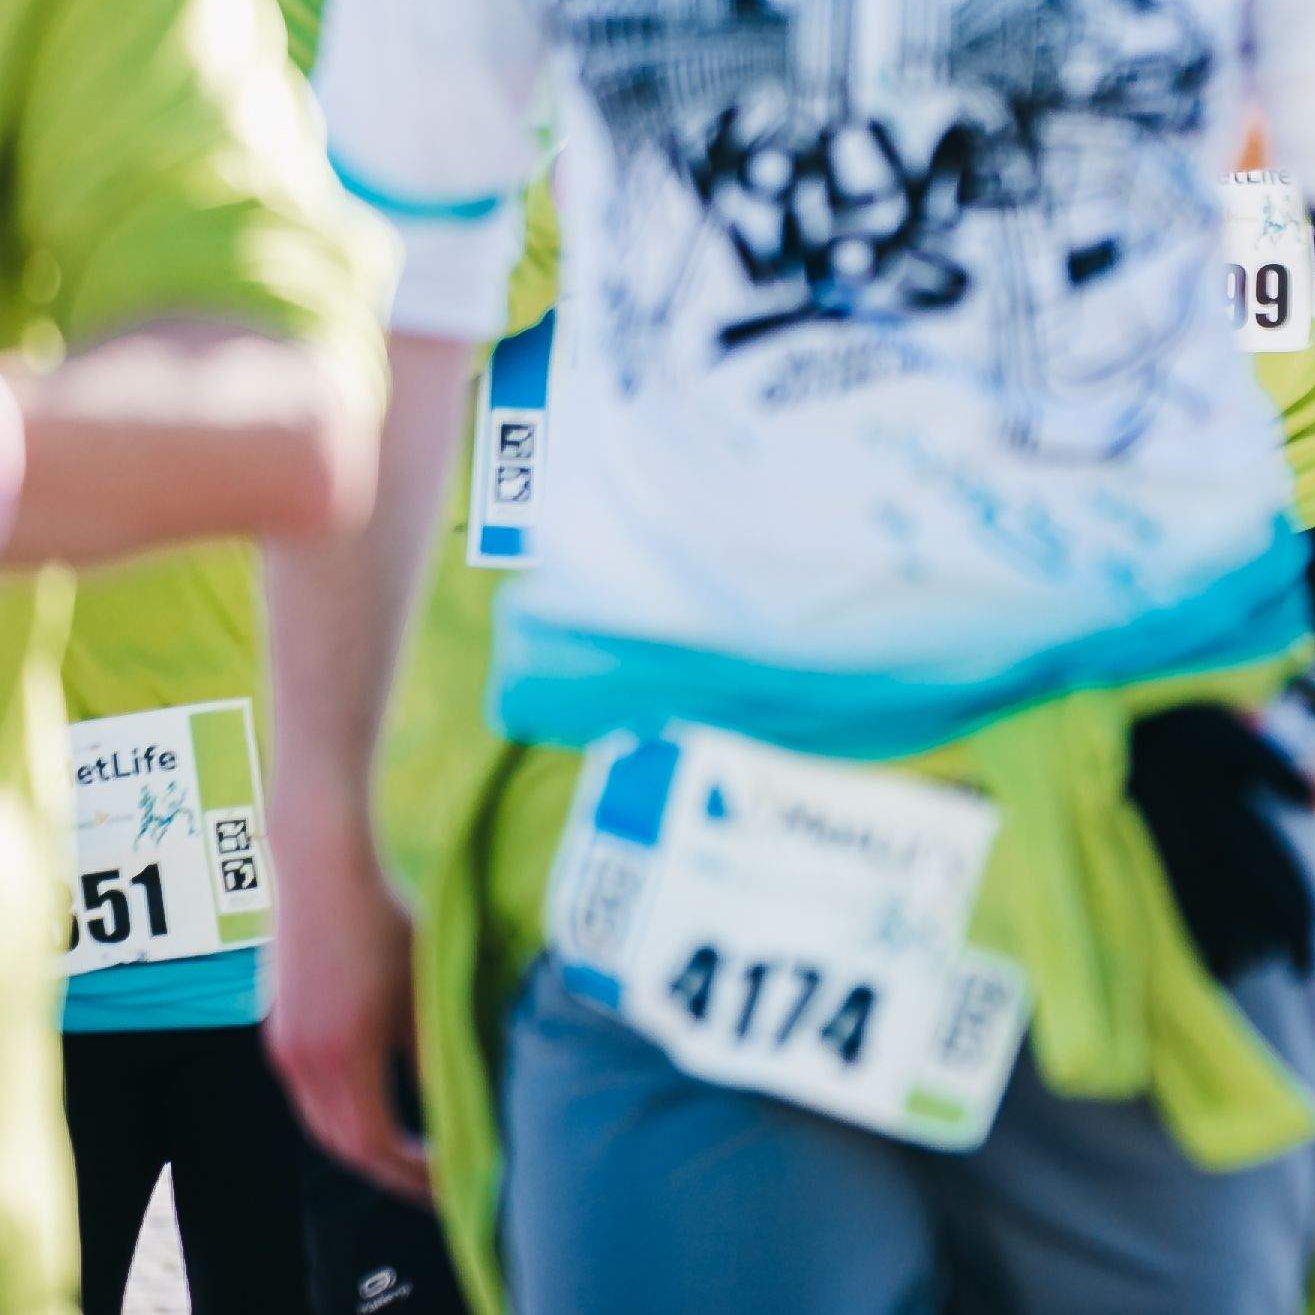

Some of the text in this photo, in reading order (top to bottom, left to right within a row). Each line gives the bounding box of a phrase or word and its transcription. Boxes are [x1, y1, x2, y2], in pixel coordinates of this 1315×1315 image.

[77, 744, 177, 785] etLife
[68, 863, 168, 952] 51
[668, 943, 876, 1065] 4174
